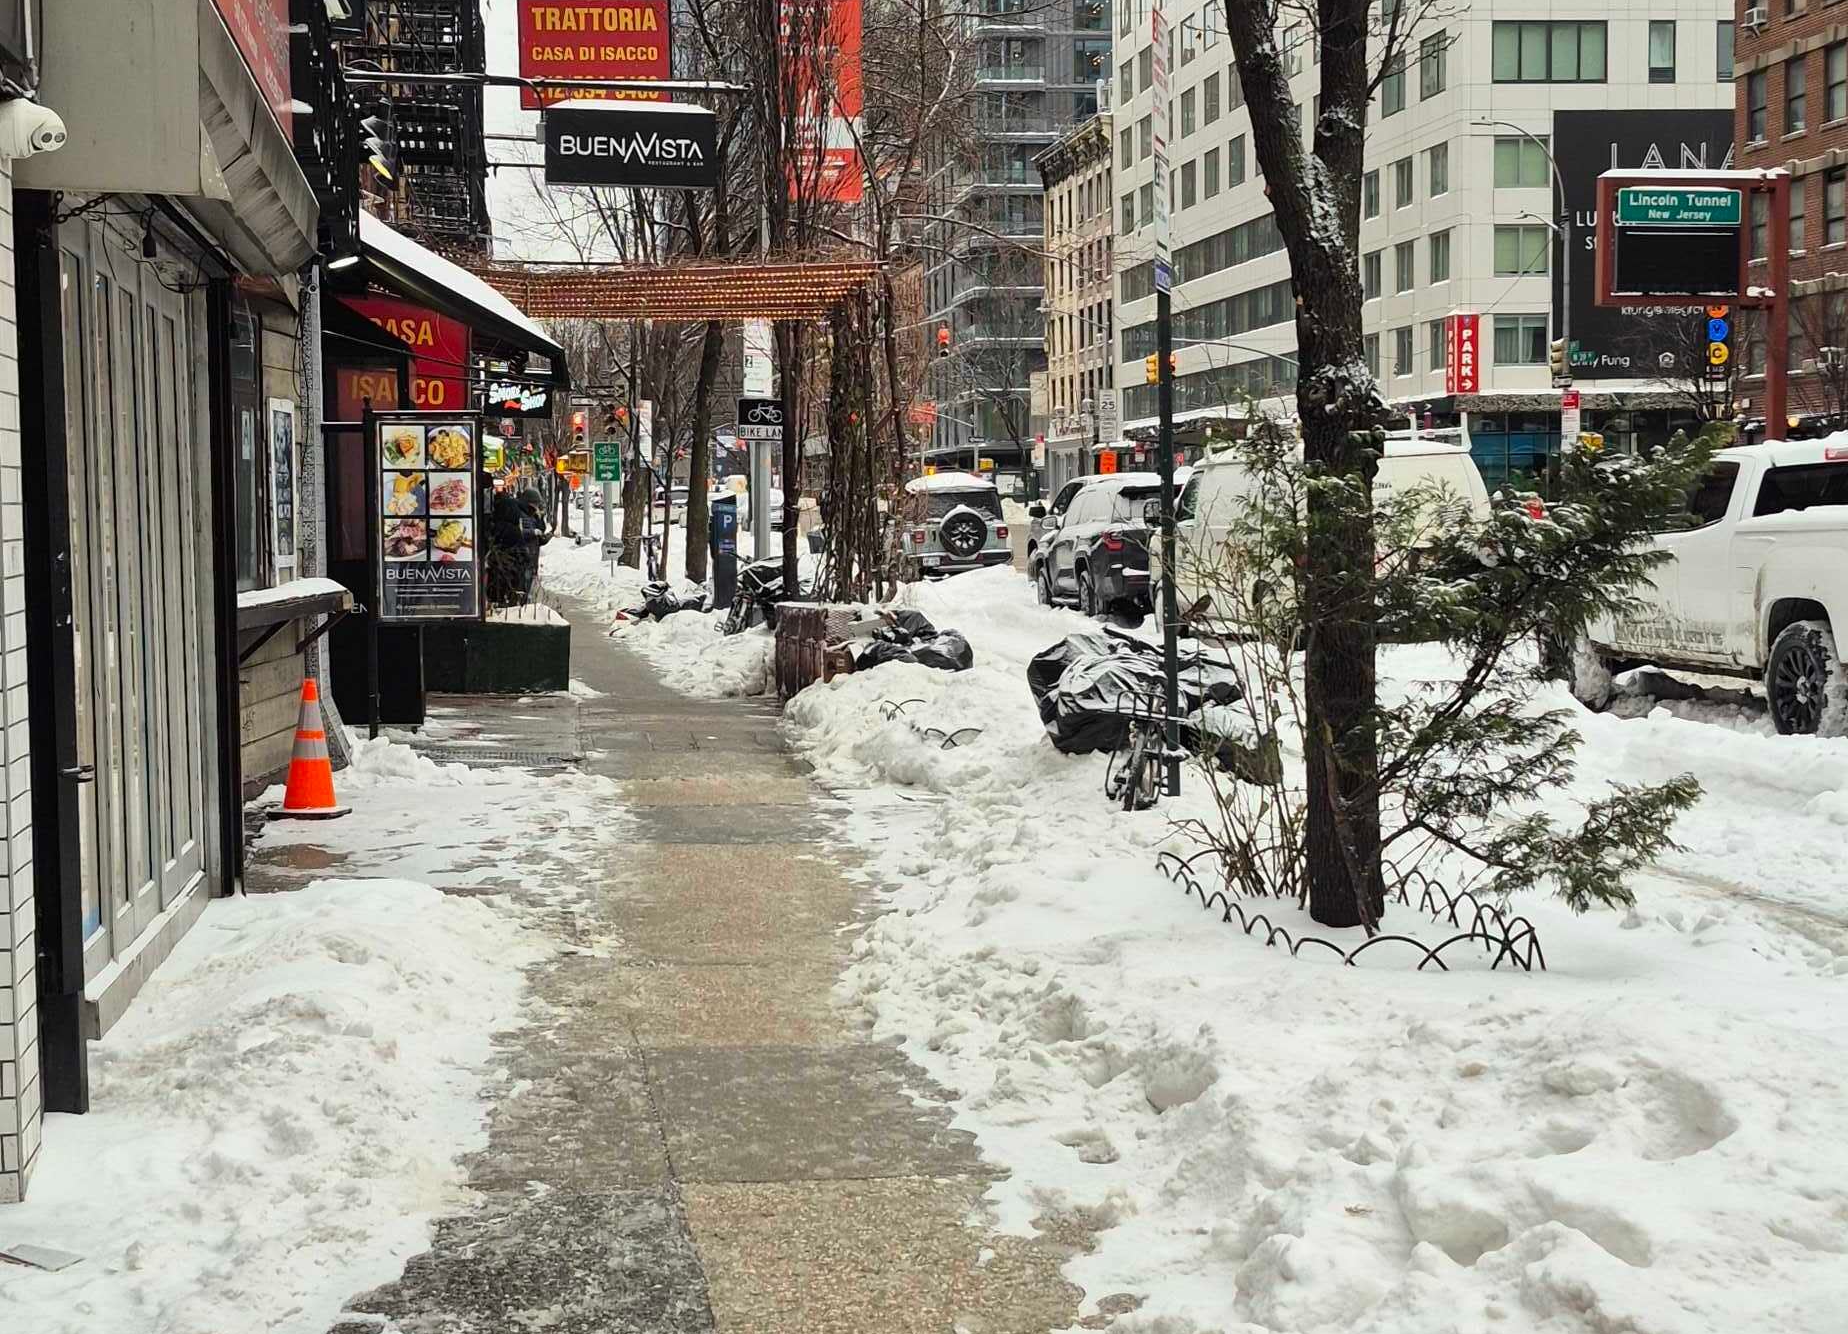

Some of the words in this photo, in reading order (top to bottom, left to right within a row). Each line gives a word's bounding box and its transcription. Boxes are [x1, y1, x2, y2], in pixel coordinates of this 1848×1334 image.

[532, 8, 657, 31] TRATTORIA
[532, 46, 574, 61] CASA
[580, 47, 595, 61] DI
[601, 46, 658, 61] ISACCO
[560, 131, 703, 163] BUENAVISTA
[1629, 193, 1678, 207] Lincoln
[1687, 194, 1732, 207] Tunnel
[1648, 210, 1670, 219] New
[1676, 210, 1712, 221] Jersey
[368, 317, 434, 346] ASA
[1461, 329, 1473, 377] PARK
[1601, 354, 1630, 367] Fung
[1101, 401, 1115, 410] 25
[740, 427, 762, 437] BIKE
[766, 427, 783, 438] LAN
[723, 515, 732, 528] P
[386, 566, 472, 583] BUENAVISTA
